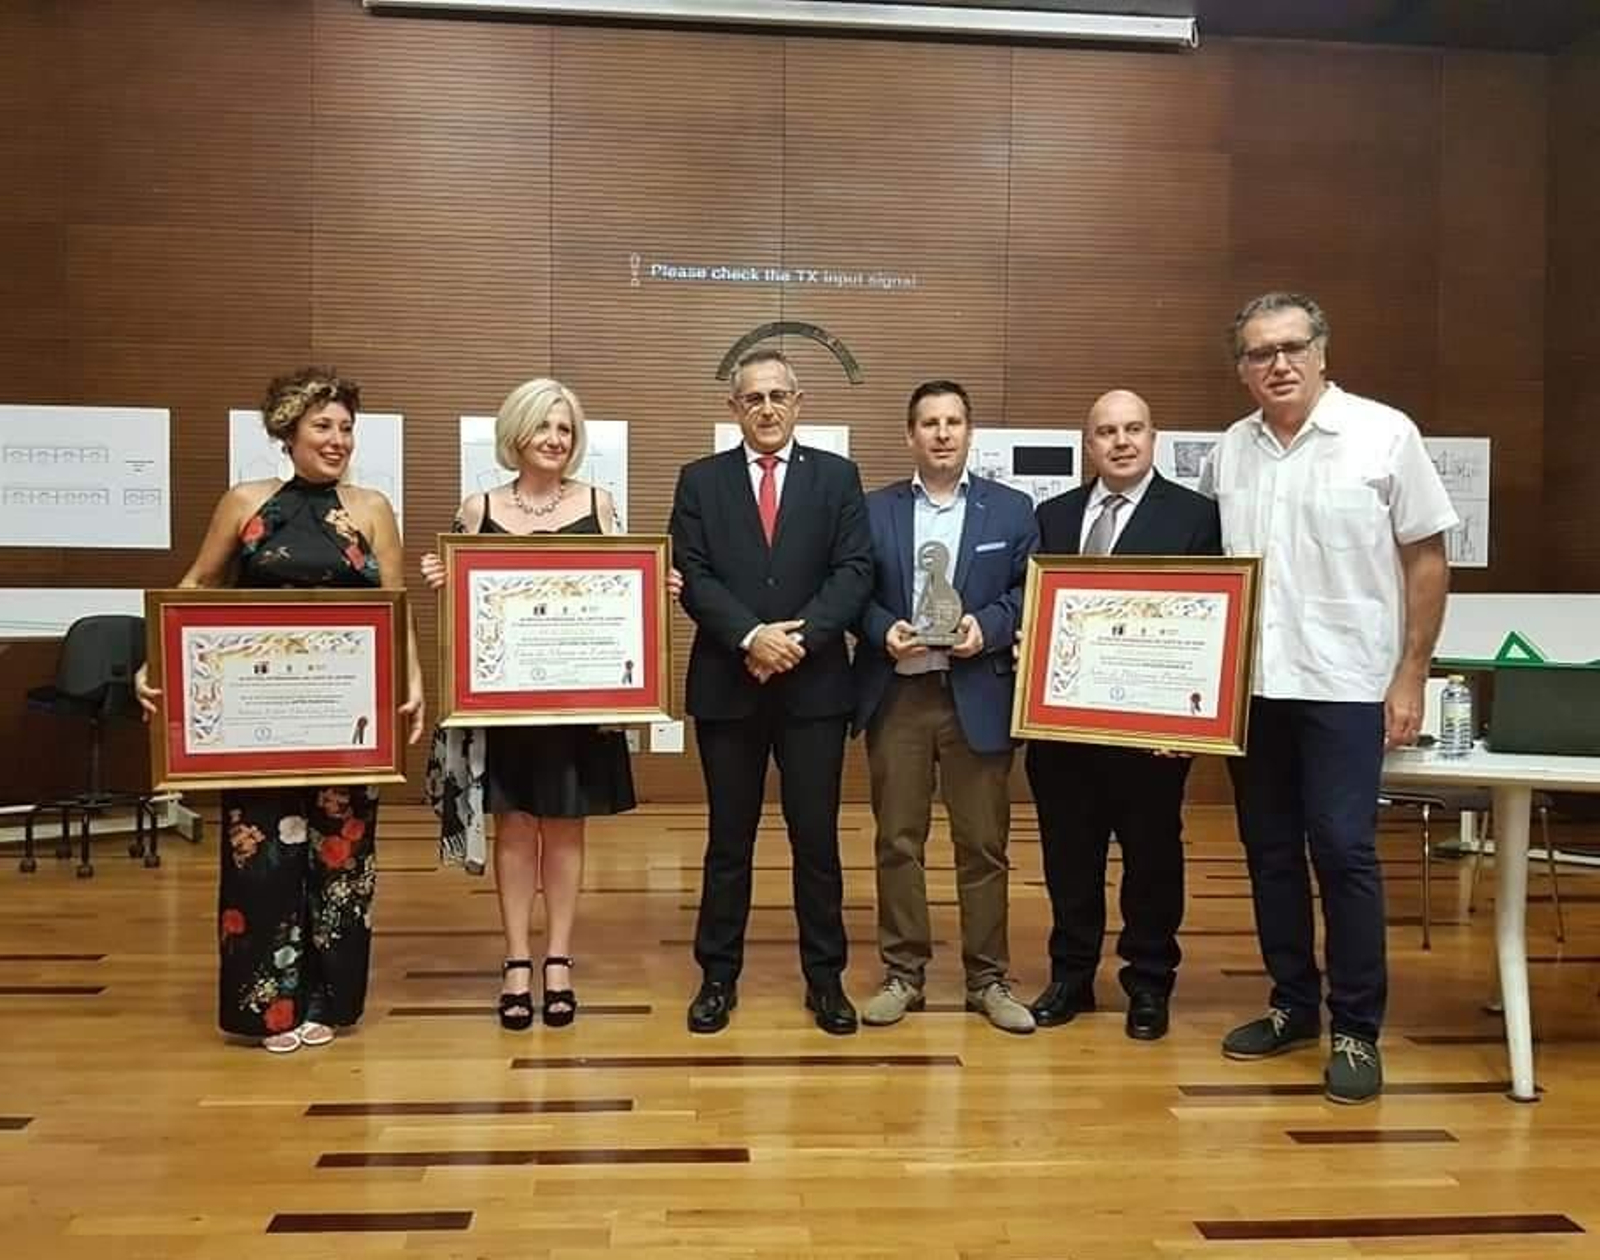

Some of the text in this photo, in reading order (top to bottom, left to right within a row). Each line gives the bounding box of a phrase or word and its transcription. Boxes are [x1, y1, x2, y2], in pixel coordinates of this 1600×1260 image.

[651, 264, 706, 279] Please
[711, 266, 759, 281] check
[764, 268, 791, 282] the
[795, 269, 819, 283] TX
[823, 270, 864, 288] input
